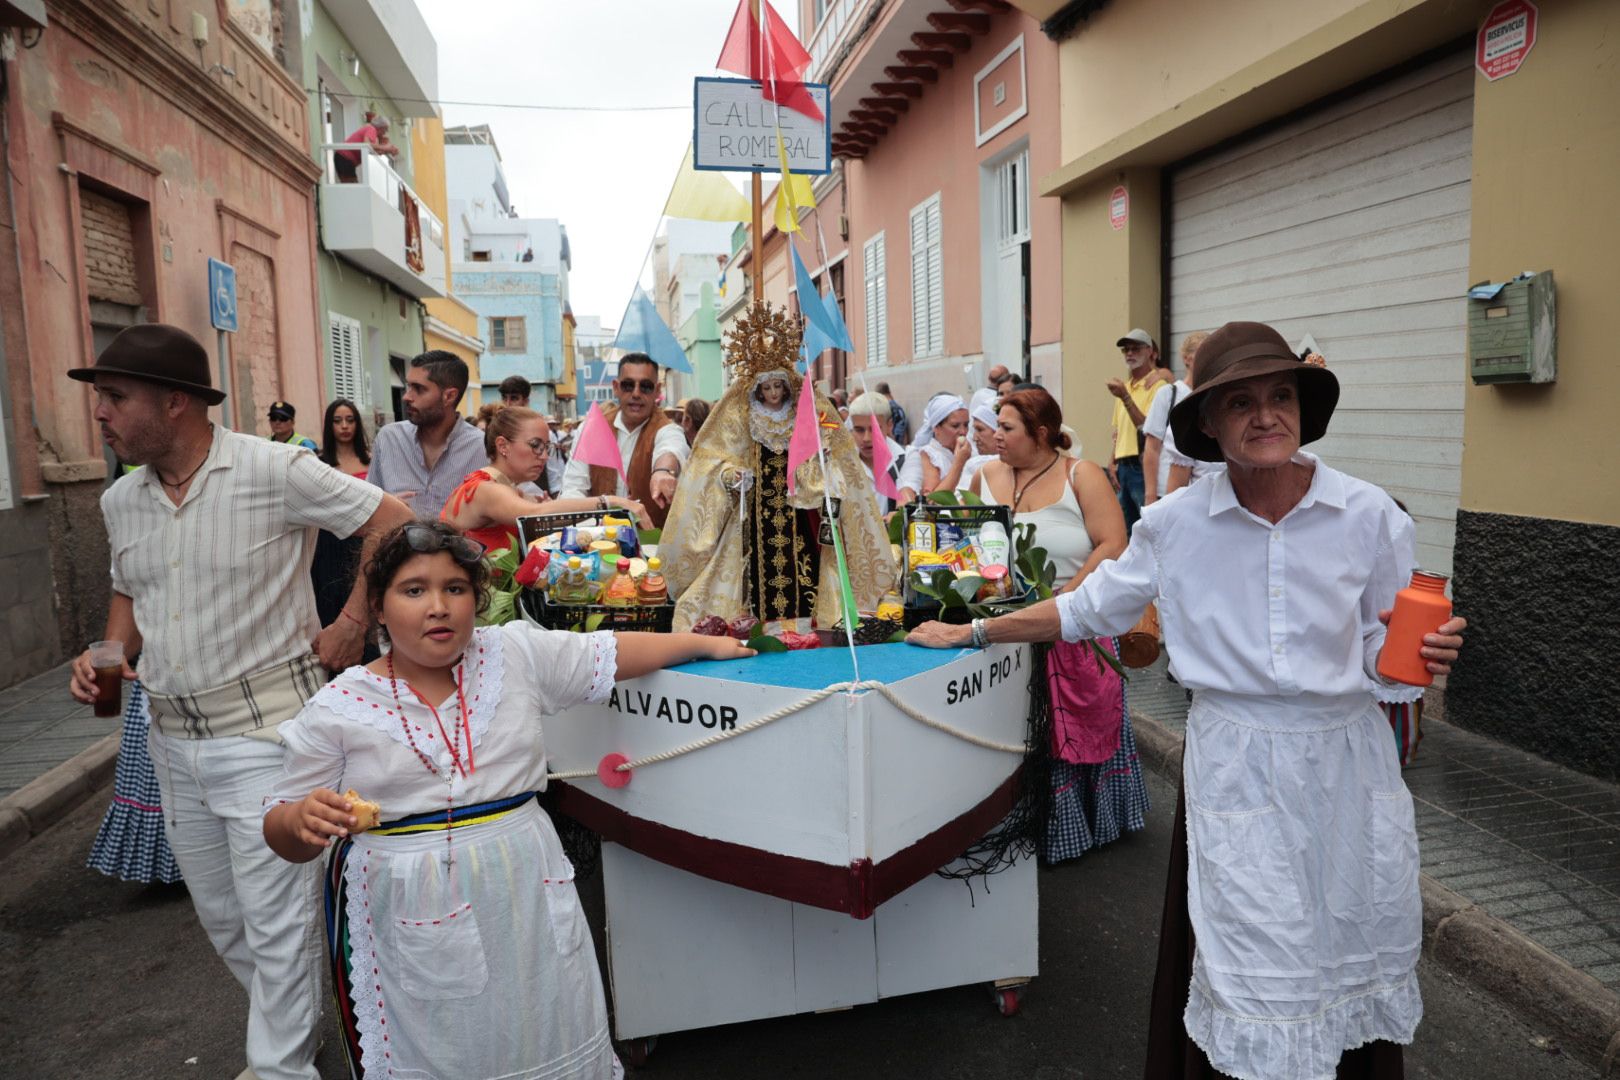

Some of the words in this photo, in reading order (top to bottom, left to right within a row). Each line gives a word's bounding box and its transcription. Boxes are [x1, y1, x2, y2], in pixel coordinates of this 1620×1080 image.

[705, 101, 794, 129] CALLE
[719, 135, 820, 159] ROMERAL
[947, 669, 982, 705] SAN
[990, 655, 1011, 687] PIO
[1015, 646, 1022, 671] X
[608, 686, 738, 732] ALVADOR
